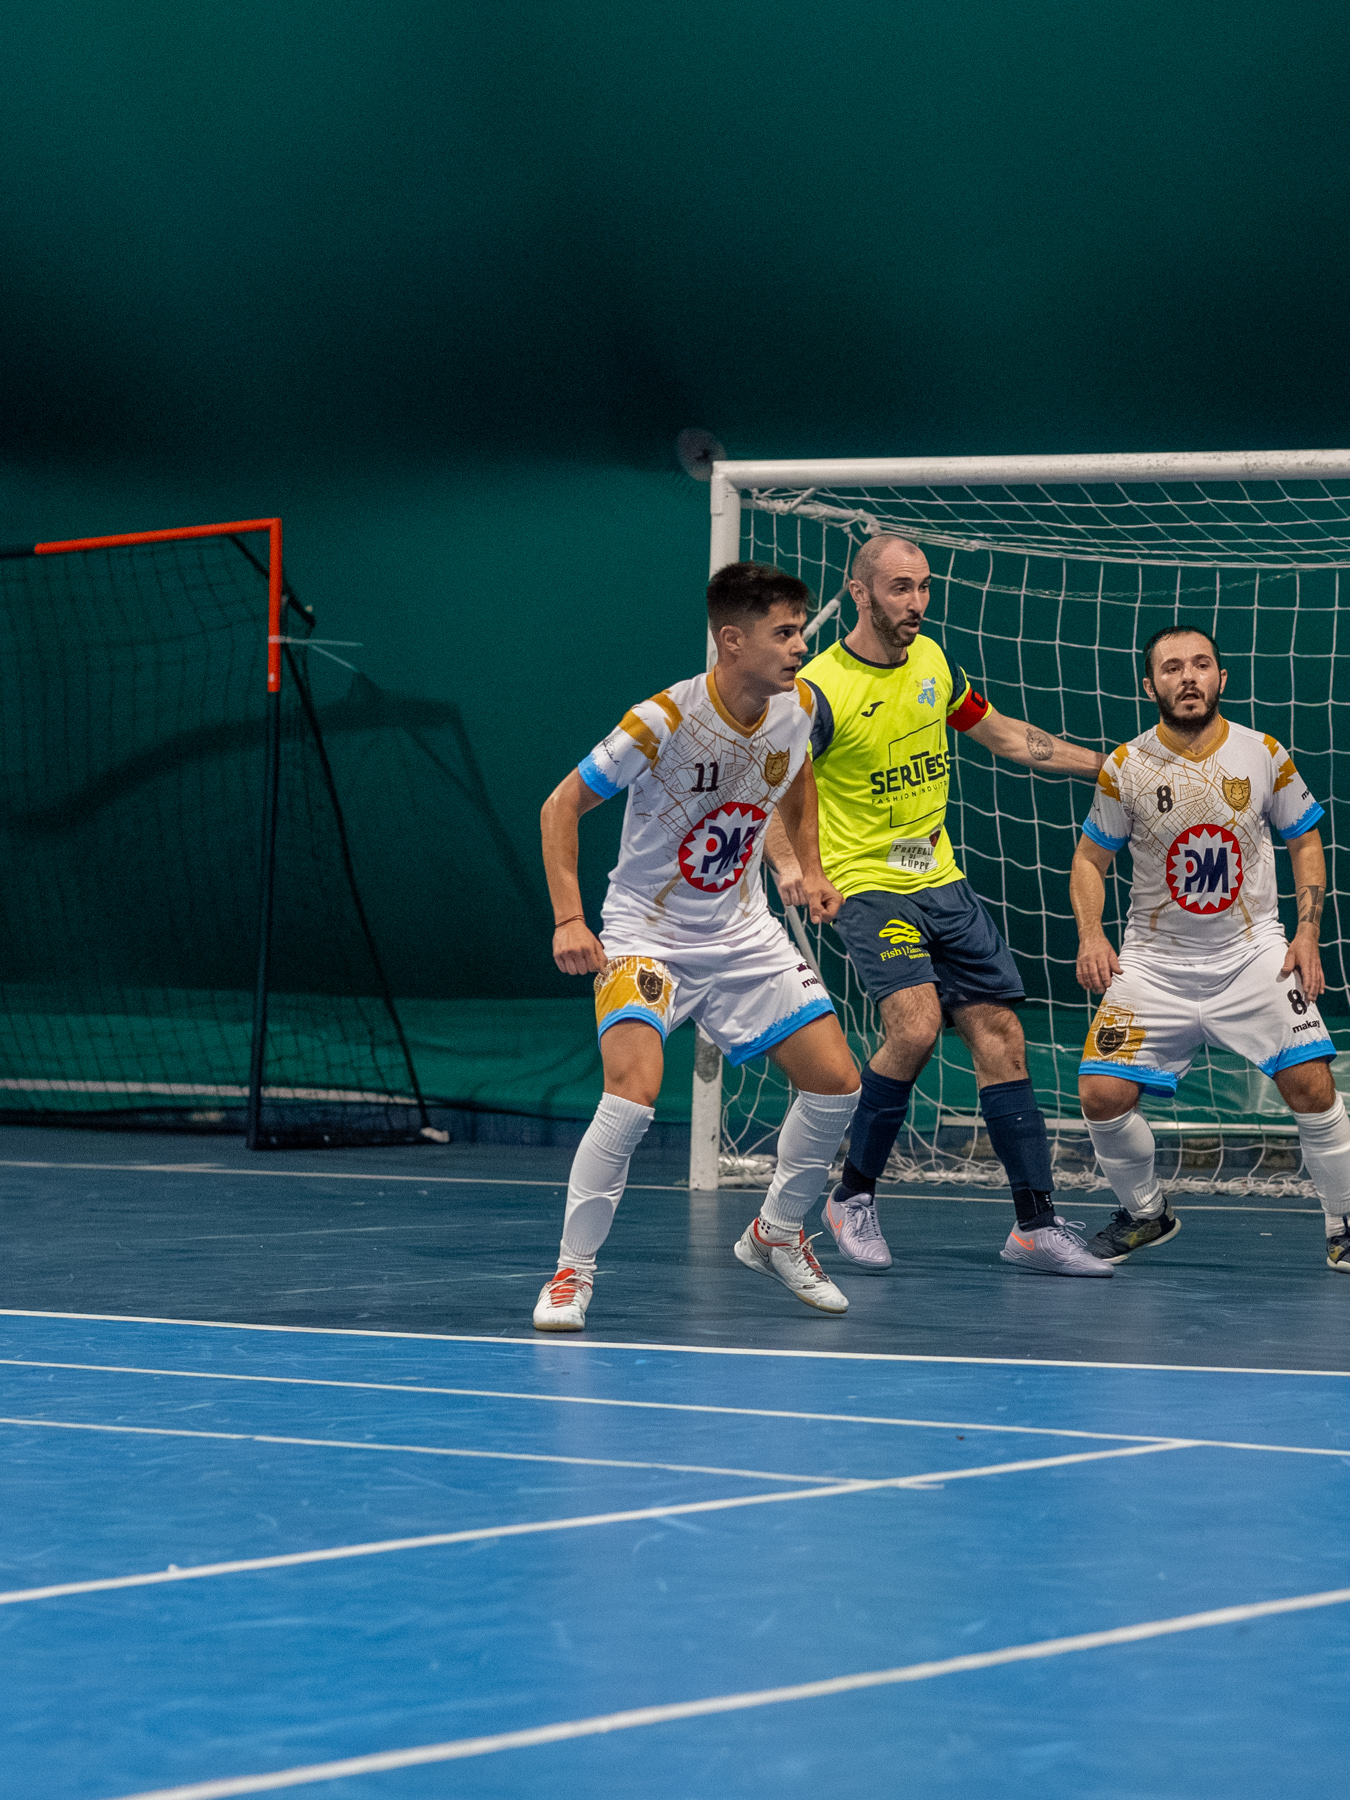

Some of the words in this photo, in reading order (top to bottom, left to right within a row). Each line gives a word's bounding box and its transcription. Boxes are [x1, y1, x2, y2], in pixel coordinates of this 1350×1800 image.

[691, 761, 719, 792] 11
[871, 790, 917, 804] FASHION
[1156, 785, 1174, 813] 8
[1184, 847, 1229, 893] PM
[880, 947, 903, 962] Fish
[1287, 989, 1307, 1015] 8
[1292, 1020, 1320, 1034] makay
